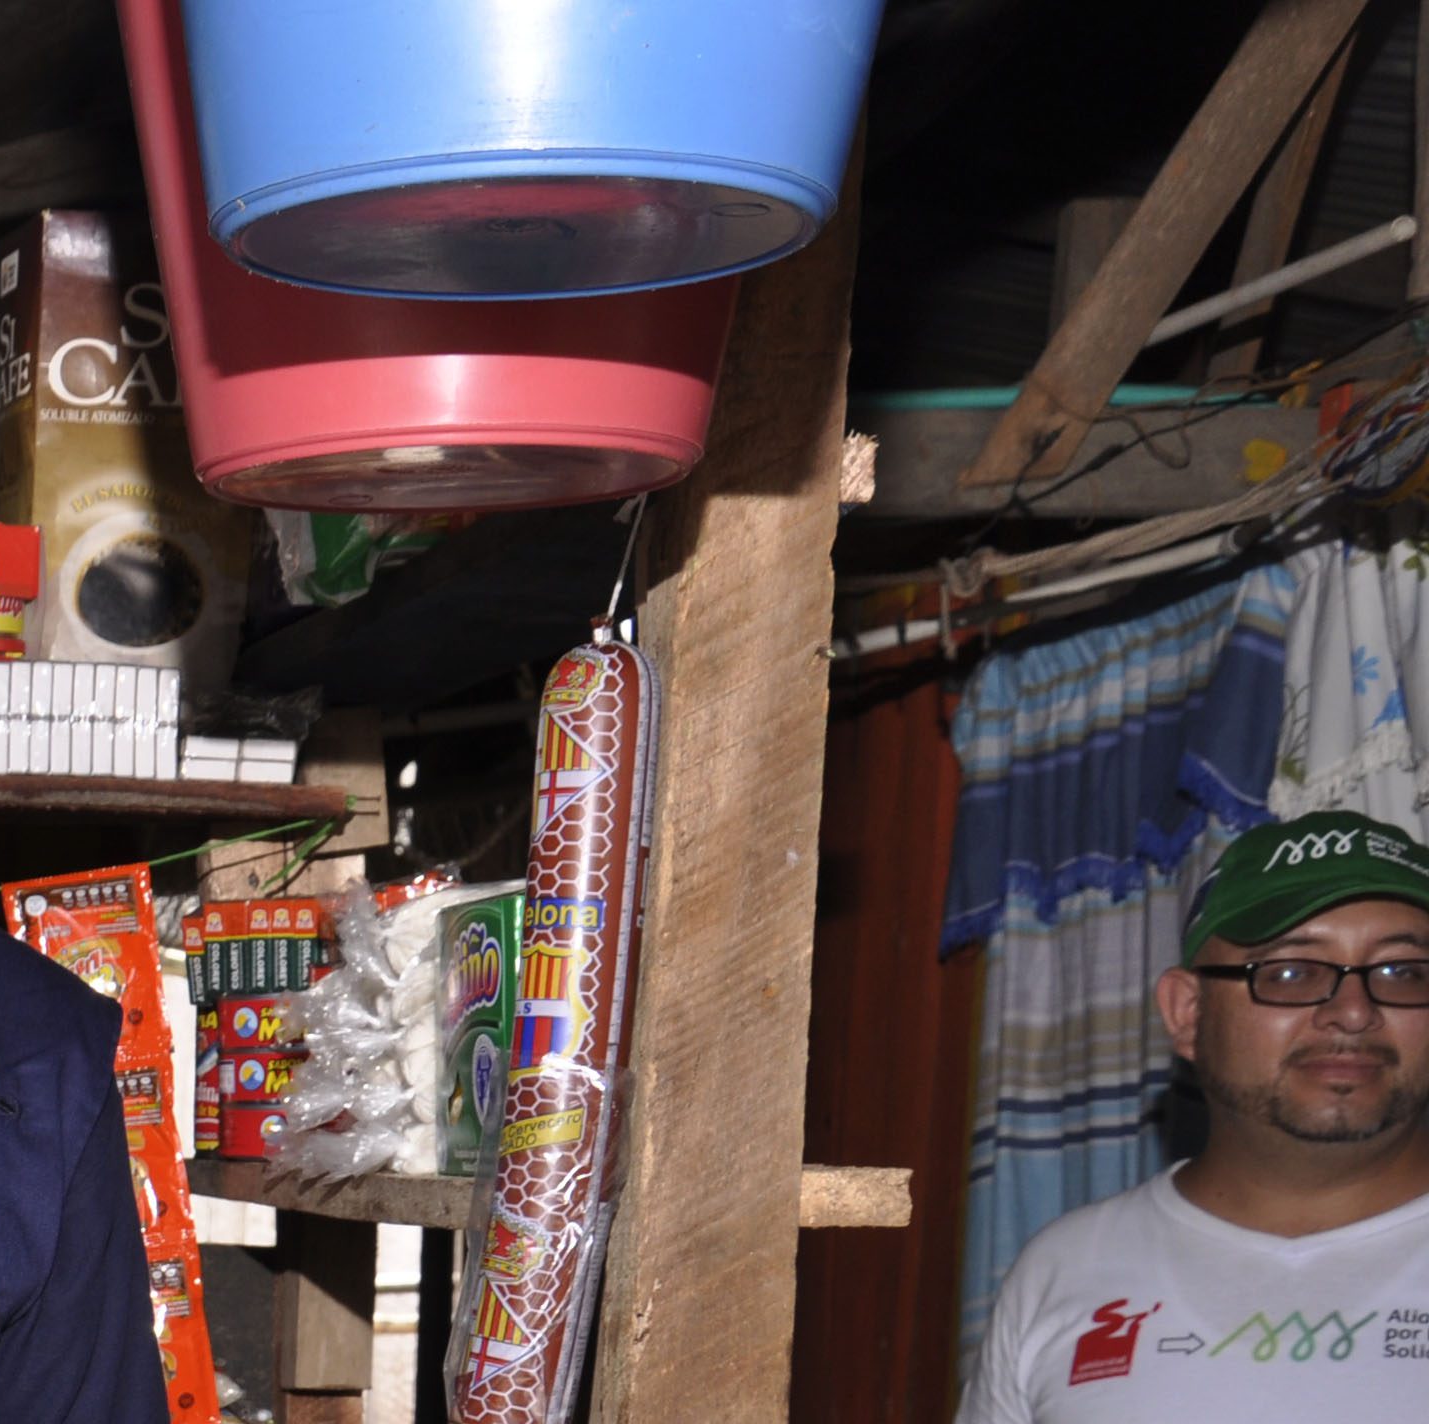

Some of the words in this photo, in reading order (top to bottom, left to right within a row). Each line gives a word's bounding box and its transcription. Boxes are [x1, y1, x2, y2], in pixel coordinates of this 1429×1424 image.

[120, 282, 170, 348] S
[47, 335, 182, 408] CA
[40, 407, 88, 422] SOLUBLE
[211, 942, 221, 991] COLOREY
[229, 941, 240, 990] COLOREY
[256, 938, 266, 988] COLOREY
[278, 938, 289, 988] COLOREY
[1384, 1327, 1422, 1343] por
